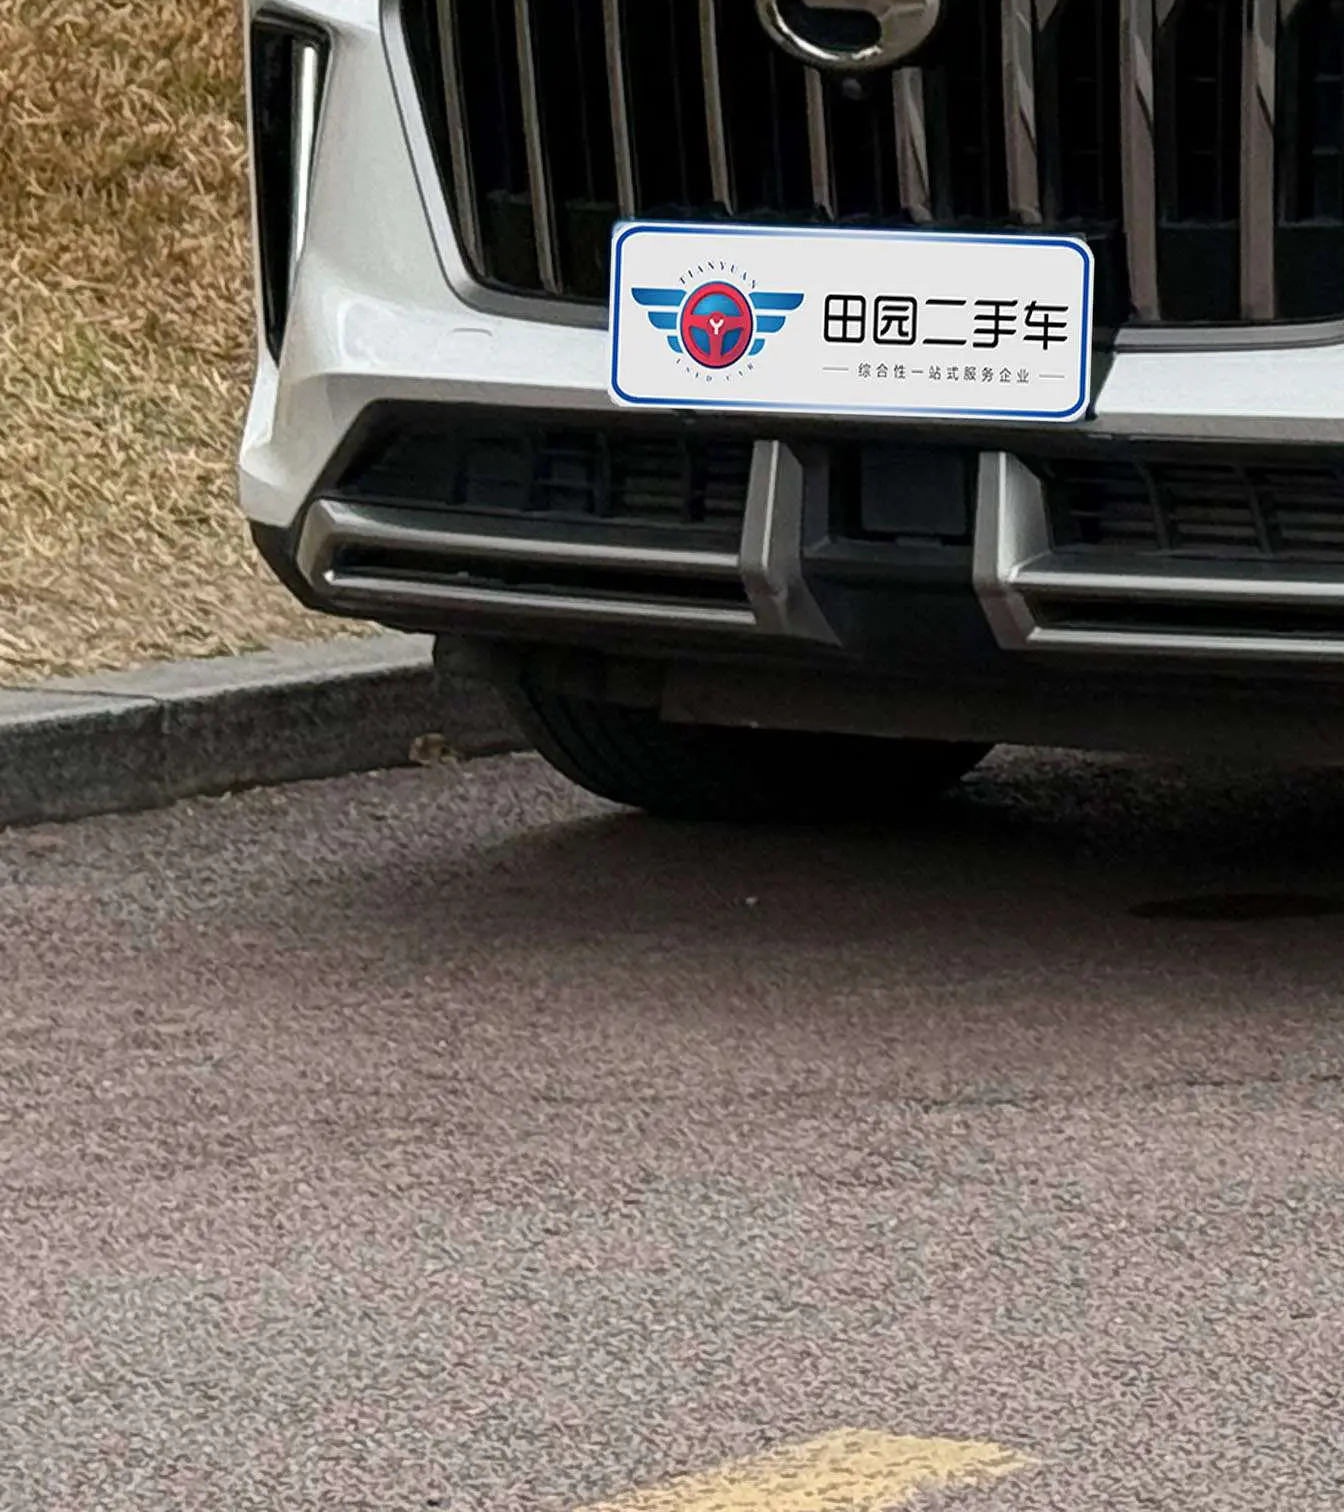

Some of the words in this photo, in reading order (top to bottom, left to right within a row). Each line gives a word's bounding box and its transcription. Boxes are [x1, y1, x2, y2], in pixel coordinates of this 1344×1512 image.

[823, 294, 1070, 350] 田园二手车
[857, 362, 1030, 384] 综合性一站式服务企业
